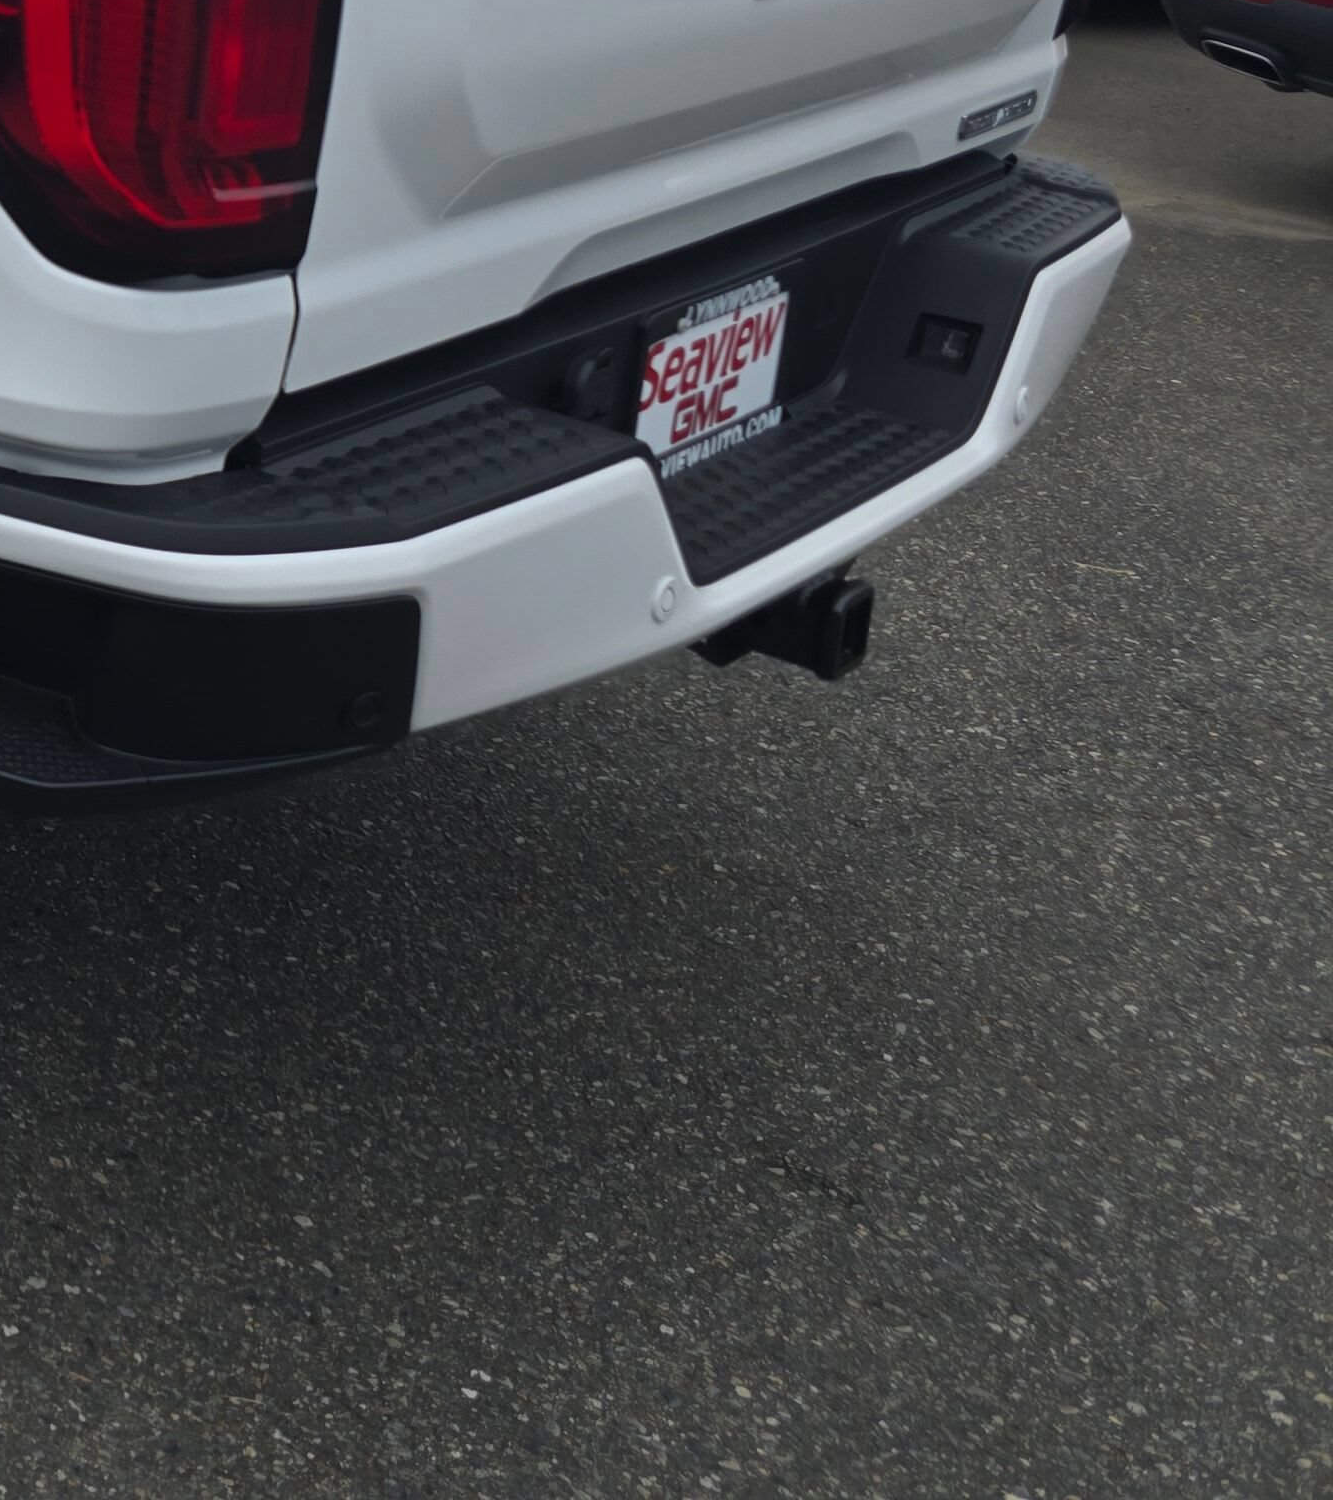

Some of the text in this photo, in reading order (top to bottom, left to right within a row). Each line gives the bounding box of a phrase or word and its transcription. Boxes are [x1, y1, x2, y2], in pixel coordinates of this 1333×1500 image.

[685, 276, 775, 327] LYNNWOOD
[637, 302, 787, 413] Seaview
[670, 374, 739, 445] GMC
